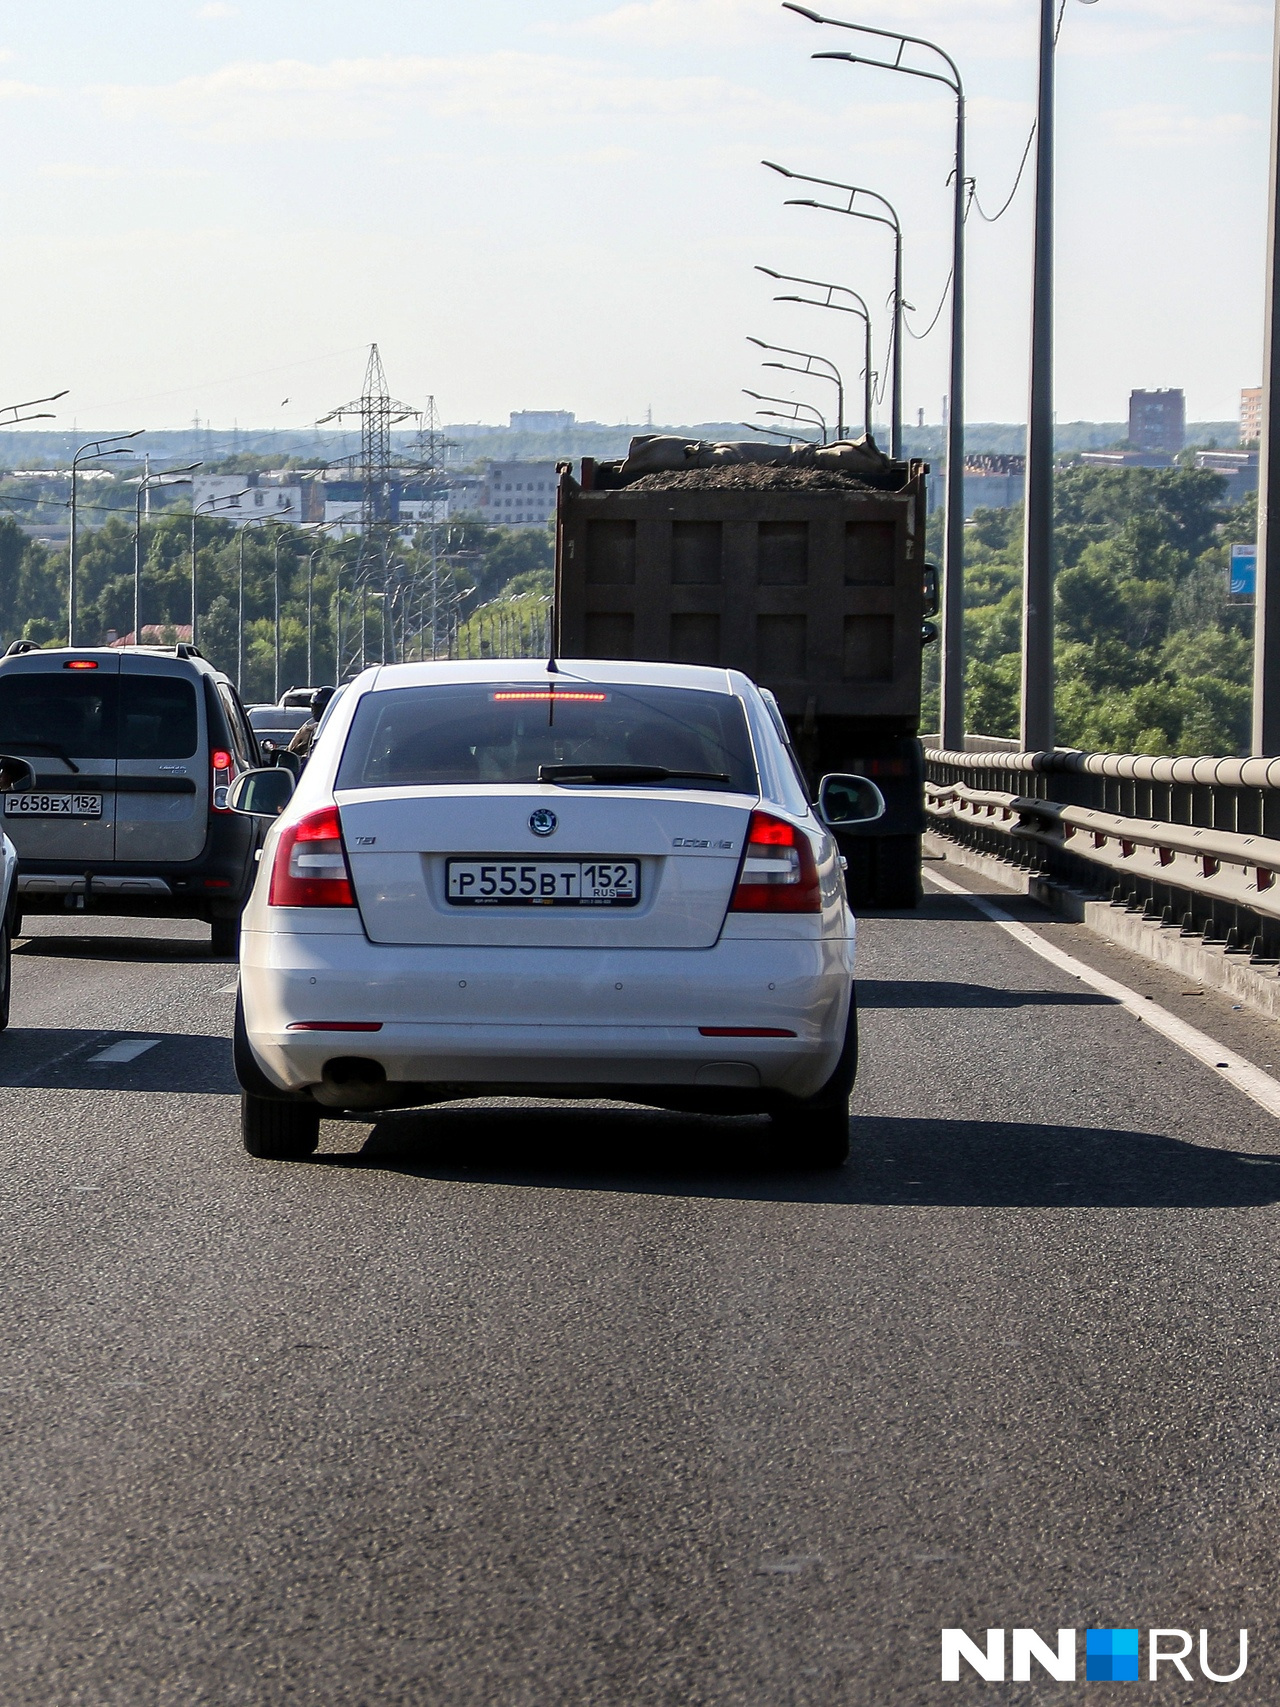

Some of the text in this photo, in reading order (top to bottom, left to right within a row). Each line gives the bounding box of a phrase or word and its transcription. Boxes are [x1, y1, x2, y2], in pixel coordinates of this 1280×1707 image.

[74, 796, 97, 808] 152
[673, 838, 734, 849] Octavia
[584, 866, 627, 887] 152
[594, 888, 615, 897] RUS
